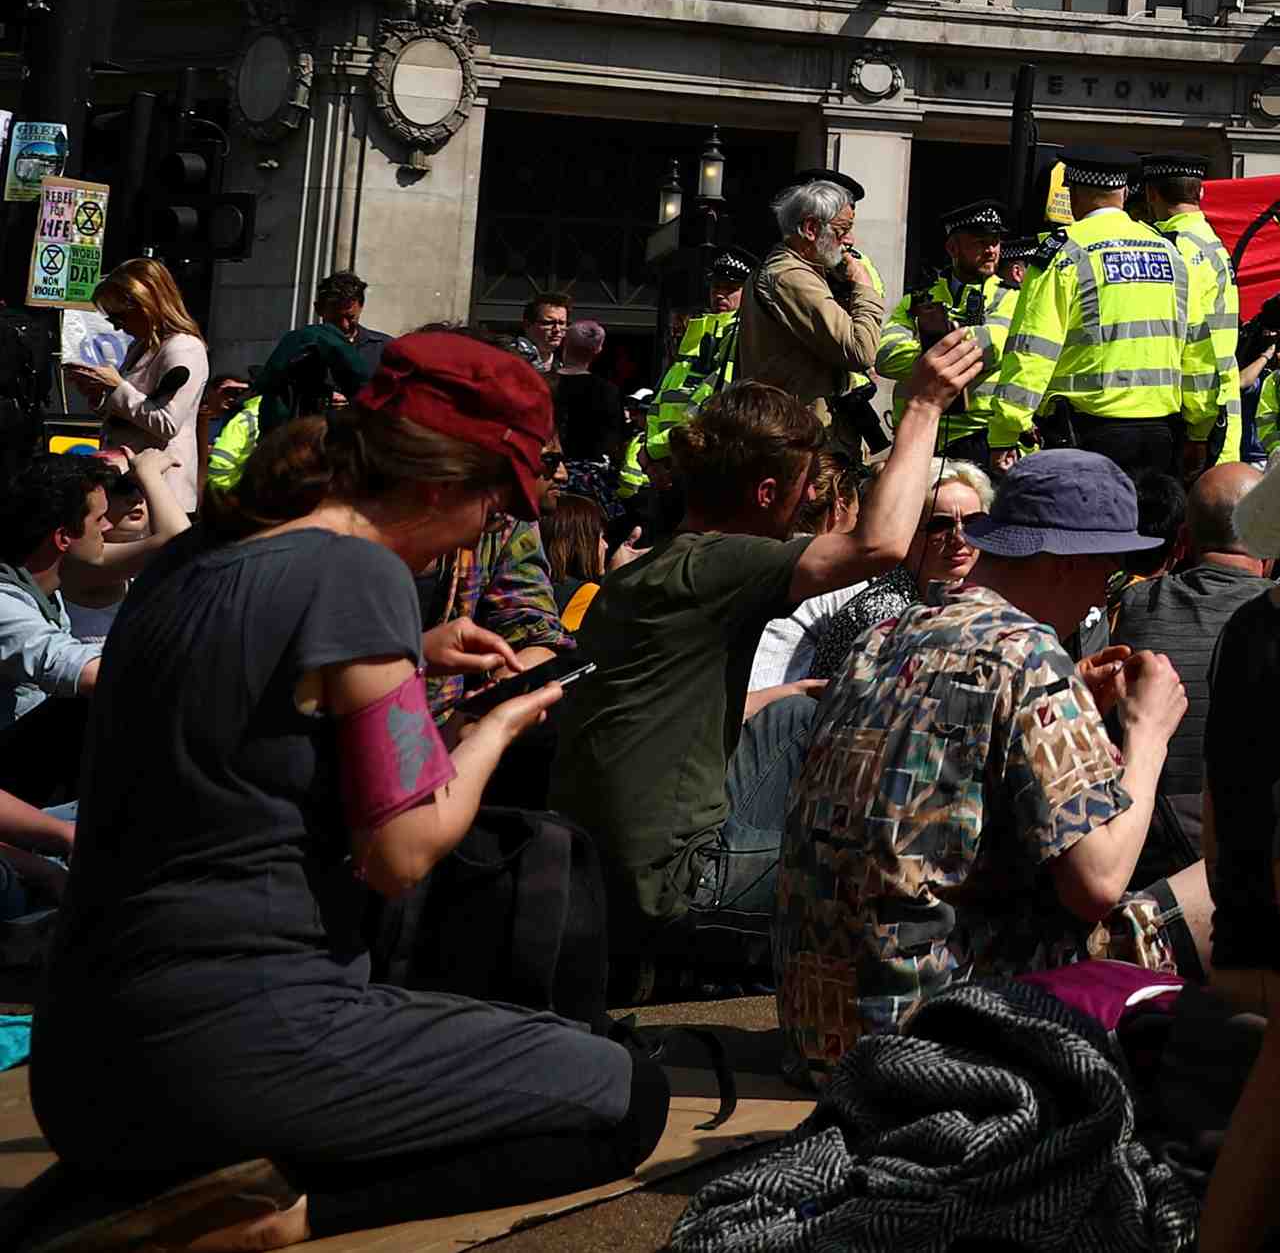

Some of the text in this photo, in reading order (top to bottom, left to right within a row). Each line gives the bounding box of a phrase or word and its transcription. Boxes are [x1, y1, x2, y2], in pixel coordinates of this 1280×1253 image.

[945, 69, 1204, 103] NIETOWN
[40, 218, 71, 238] LIFE
[71, 249, 100, 260] WORLD
[70, 265, 99, 284] DAY
[1107, 263, 1172, 279] POLICE
[42, 275, 59, 286] NON
[33, 286, 65, 298] VIOLENT
